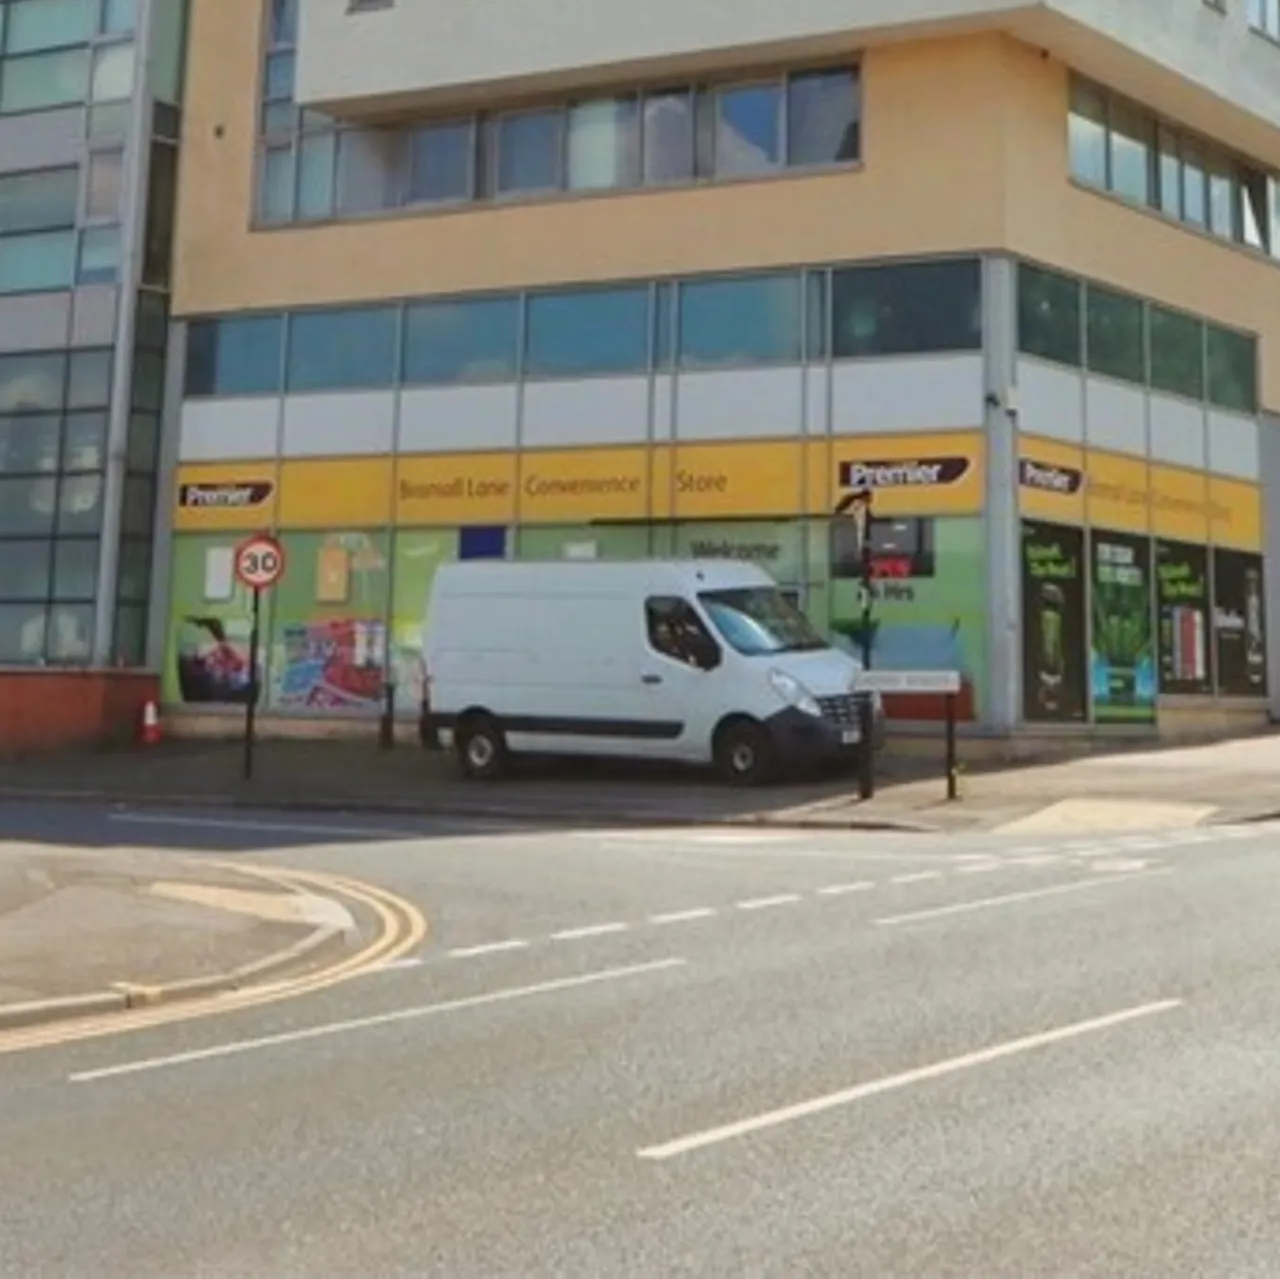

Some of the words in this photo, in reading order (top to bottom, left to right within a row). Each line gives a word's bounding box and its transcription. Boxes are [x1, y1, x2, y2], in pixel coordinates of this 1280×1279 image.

[467, 475, 510, 497] Lane
[524, 472, 642, 497] Convenience
[676, 469, 729, 493] Store
[850, 460, 942, 486] Premier
[1024, 463, 1071, 491] Premier
[185, 484, 254, 507] Premier
[690, 539, 780, 561] Welcome
[242, 551, 278, 574] 30
